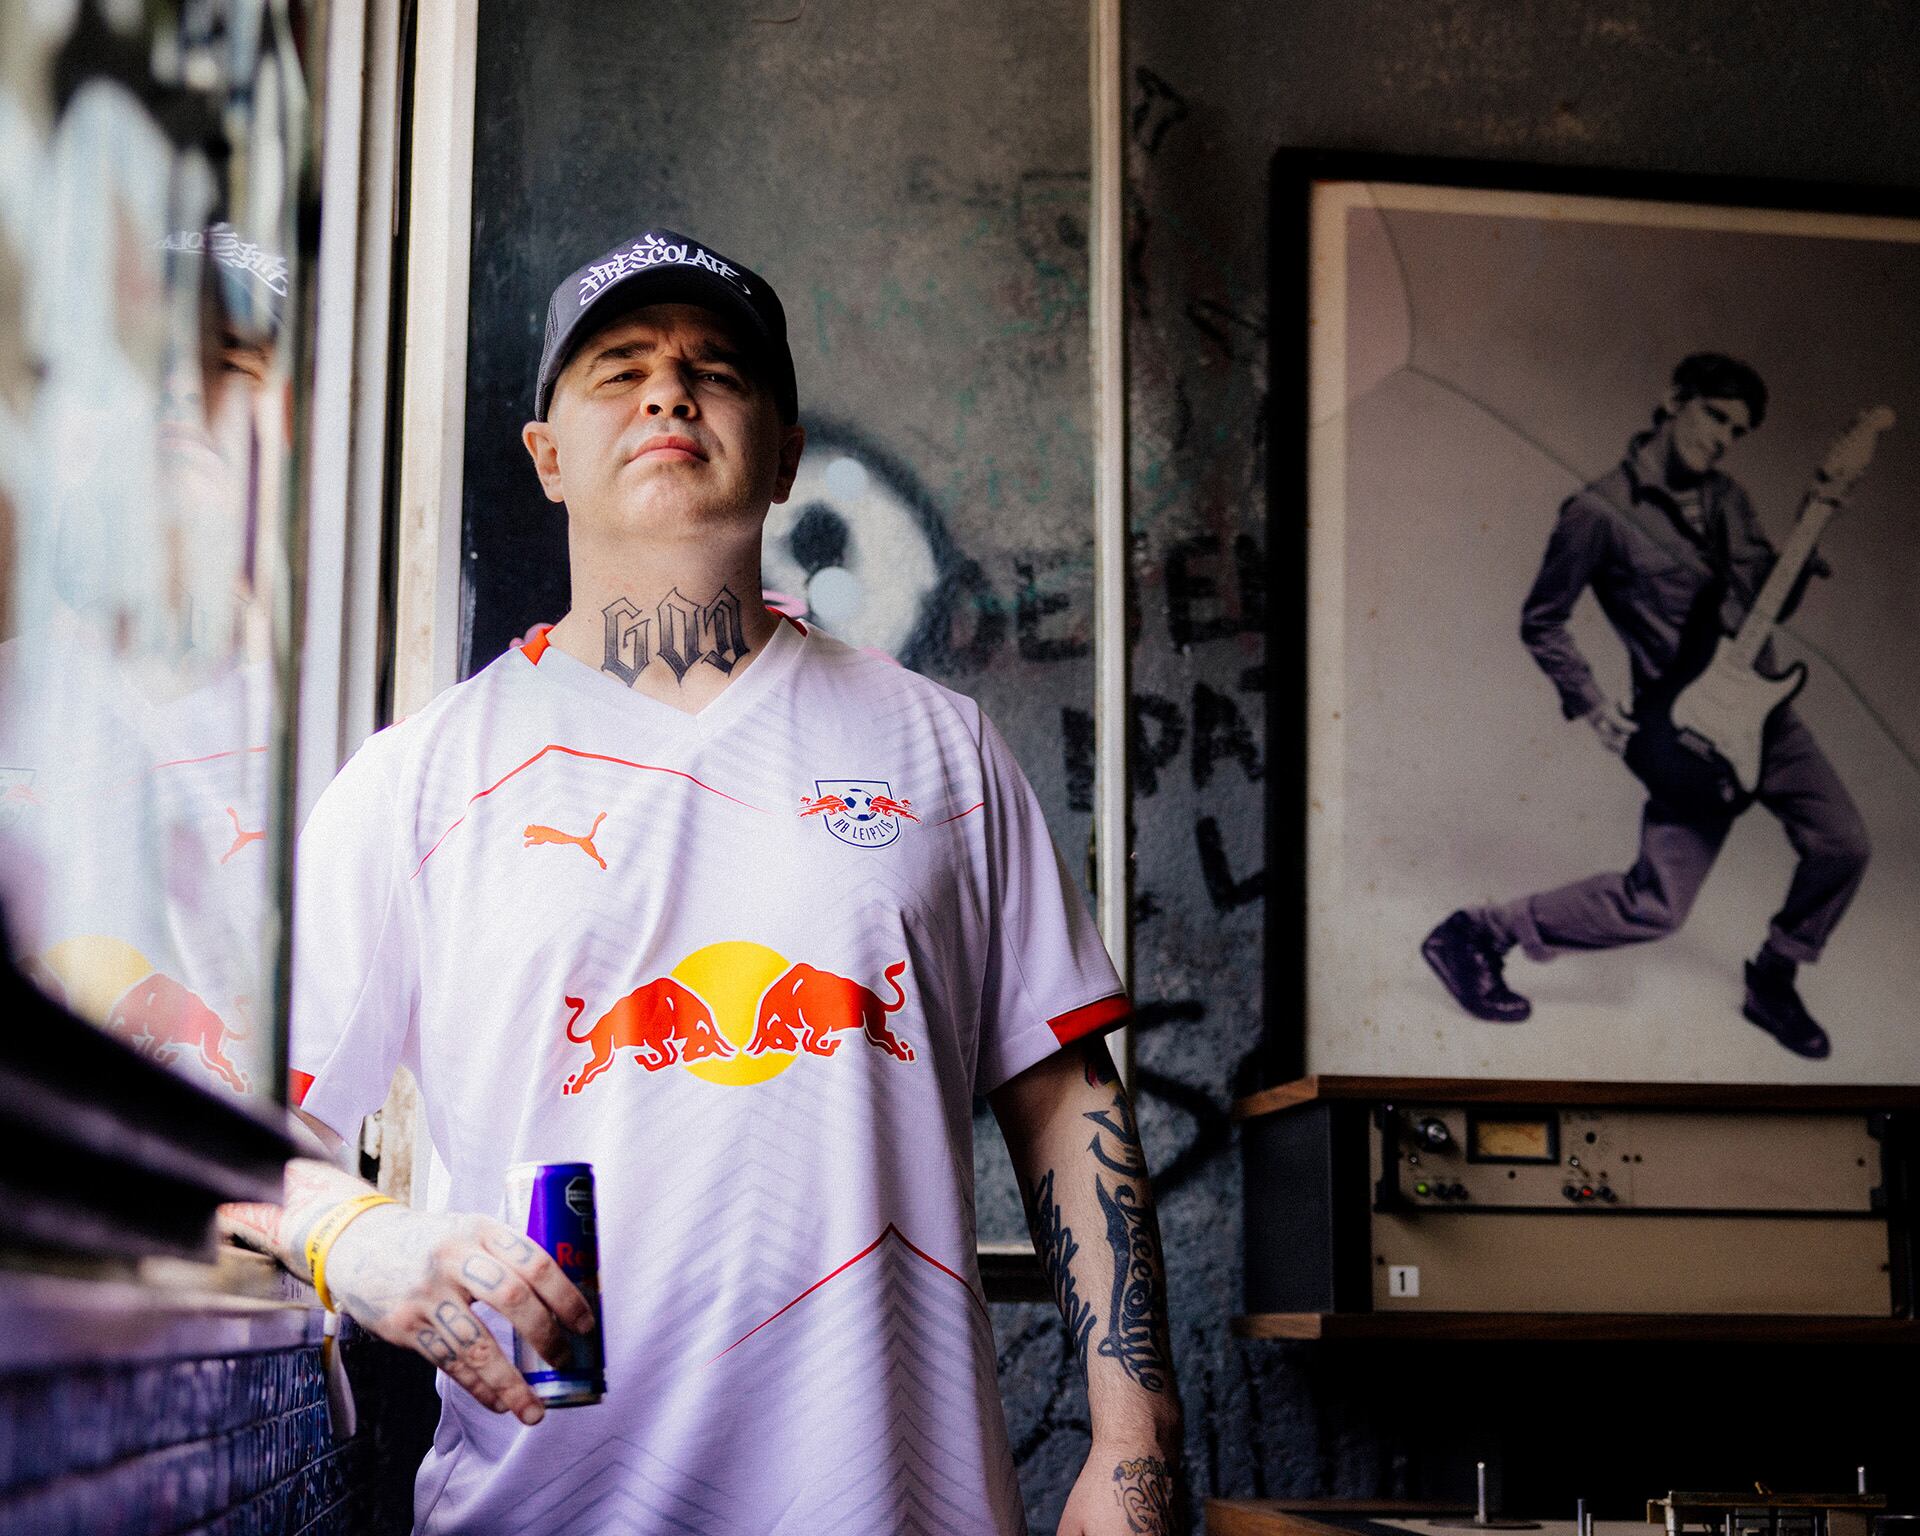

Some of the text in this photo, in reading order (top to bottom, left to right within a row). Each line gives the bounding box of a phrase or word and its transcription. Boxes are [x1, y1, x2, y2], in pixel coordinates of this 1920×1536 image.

[833, 818, 894, 841] RB LEIPZIG
[1398, 1271, 1406, 1293] 1
